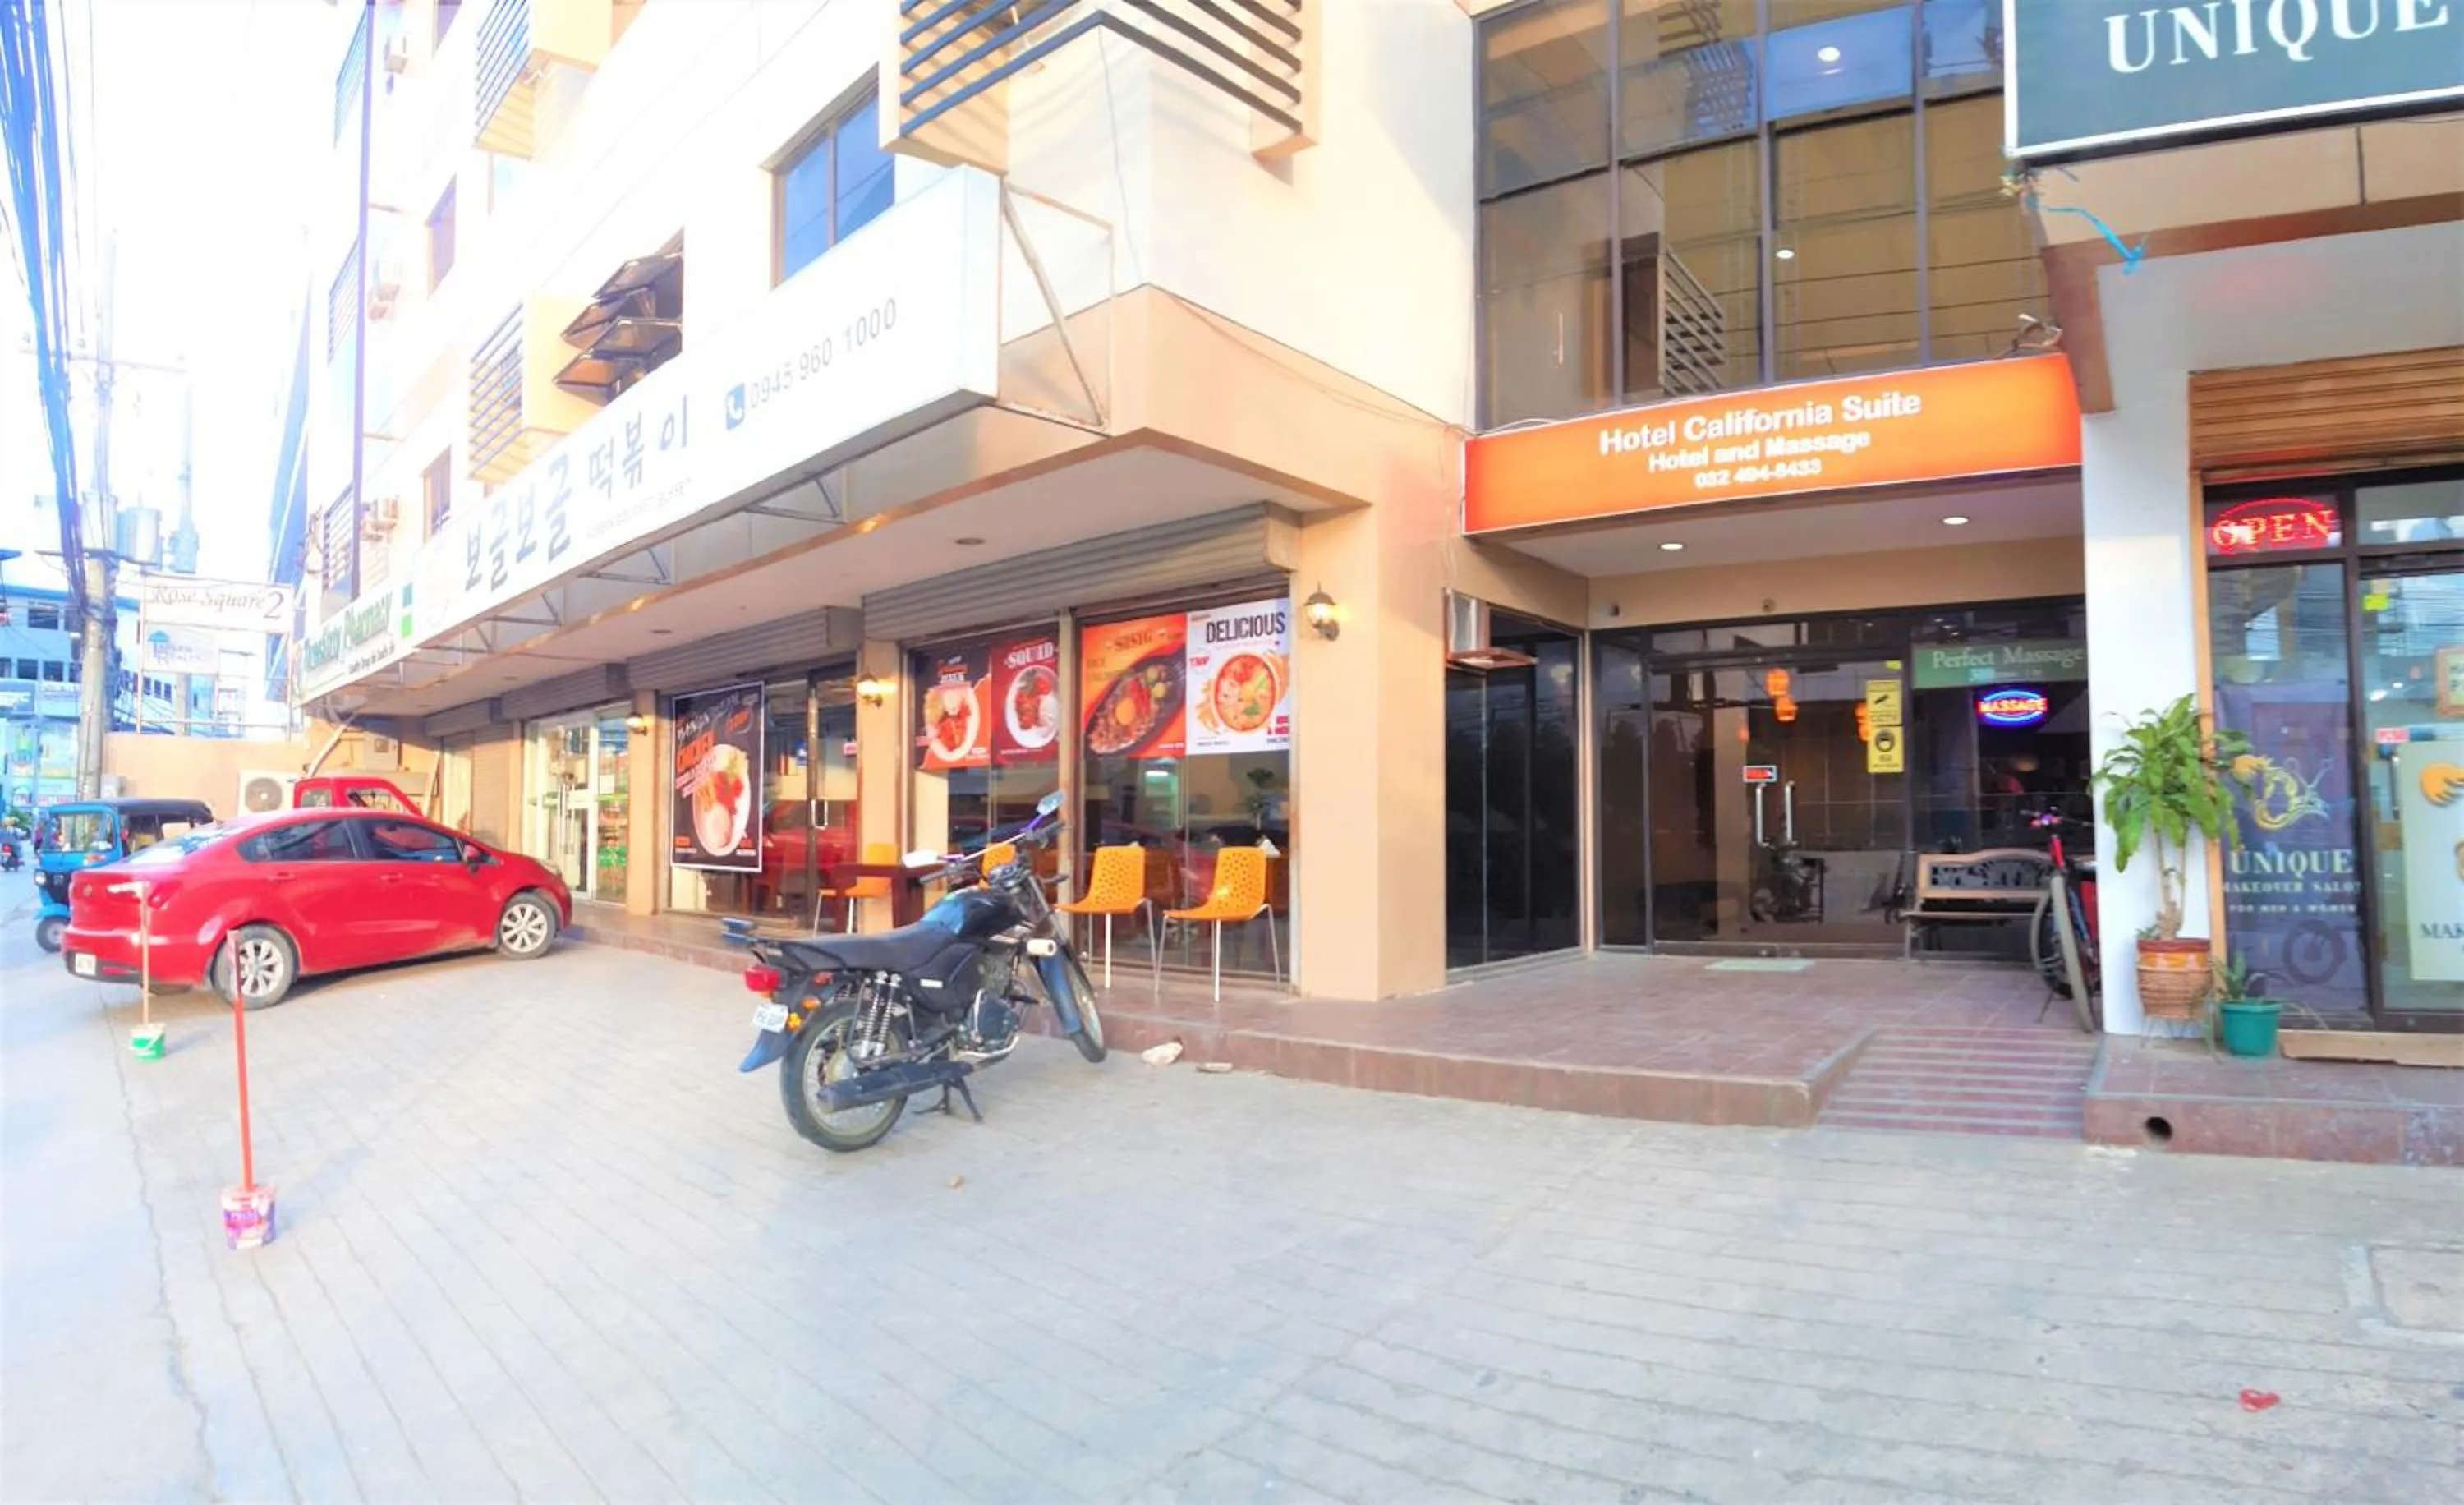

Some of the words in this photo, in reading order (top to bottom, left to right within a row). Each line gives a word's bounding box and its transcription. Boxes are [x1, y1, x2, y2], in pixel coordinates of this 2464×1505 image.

[2103, 0, 2448, 73] UNIQUE
[751, 361, 792, 408] 0945
[800, 337, 831, 380] 960
[841, 297, 895, 352] 1000
[1599, 420, 1676, 454] Hotel
[1683, 401, 1832, 441] California
[1841, 390, 1921, 422] Suite
[1648, 445, 1708, 472] Hotel
[1714, 440, 1759, 463] and
[1765, 432, 1870, 457] Massage
[465, 453, 573, 592] 보글보글
[588, 393, 688, 501] 떡볶이
[1694, 470, 1730, 488] 032
[2213, 510, 2333, 546] OPEN
[263, 591, 284, 620] 2
[1205, 612, 1286, 643] DELICIOUS
[1932, 647, 1995, 669] Perfect
[2002, 645, 2085, 668] Massage
[1977, 697, 2048, 713] MASSAGE
[2230, 849, 2354, 878] UNIQUE
